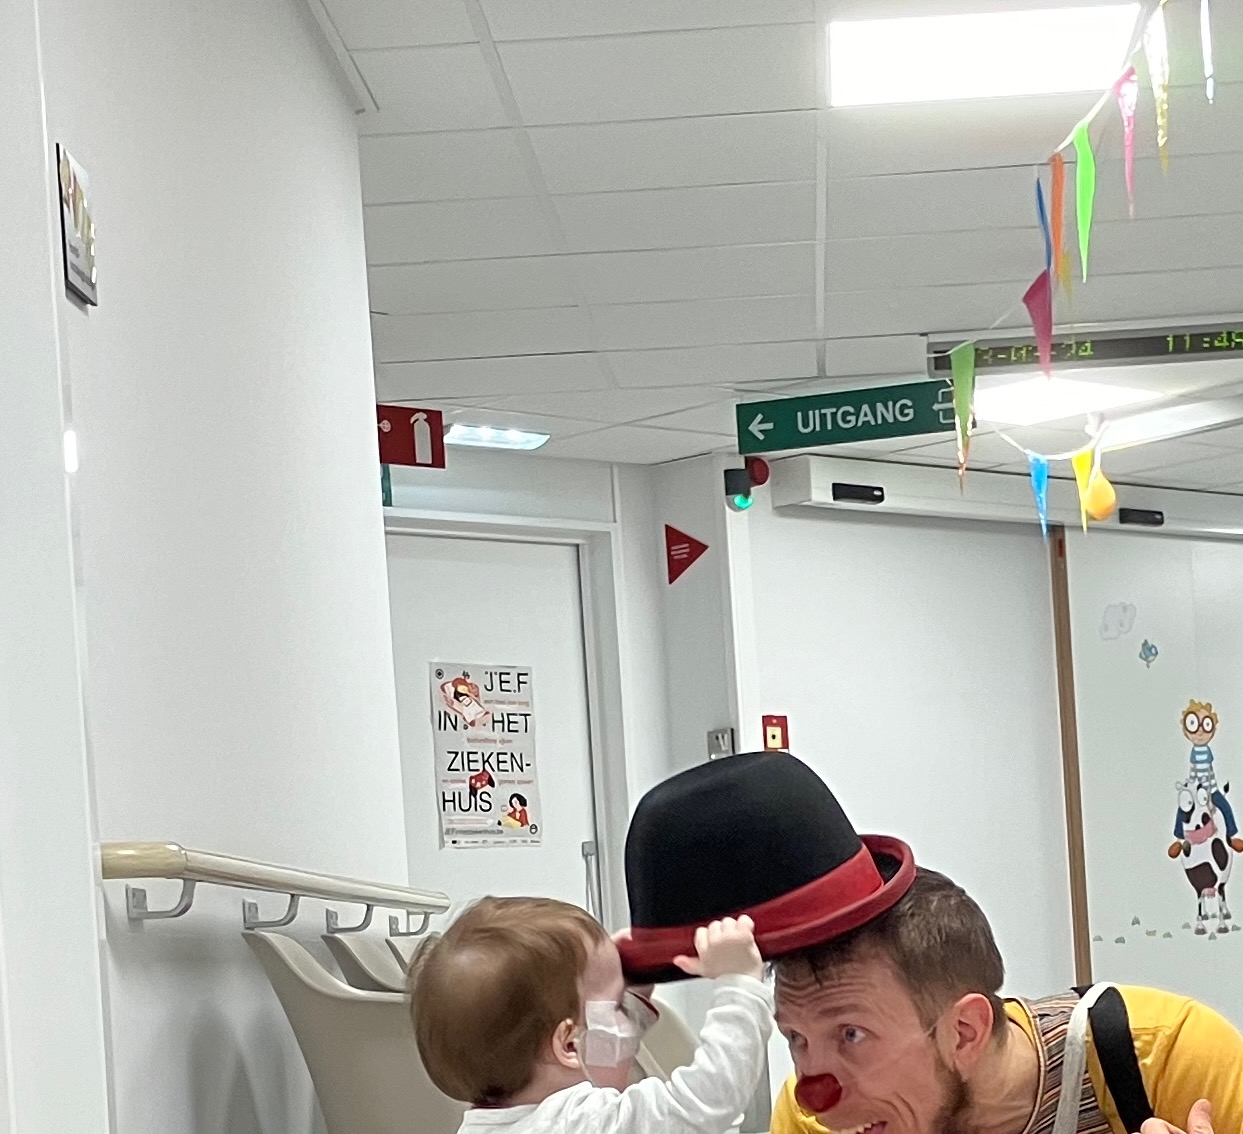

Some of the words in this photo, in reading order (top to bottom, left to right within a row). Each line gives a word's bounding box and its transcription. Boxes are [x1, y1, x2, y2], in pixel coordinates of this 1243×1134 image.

[797, 399, 914, 434] UITGANG
[484, 671, 529, 693] JEF
[438, 710, 458, 731] IN
[492, 712, 532, 733] HET
[446, 750, 532, 773] ZIEKEN-
[442, 790, 493, 812] HUIS
